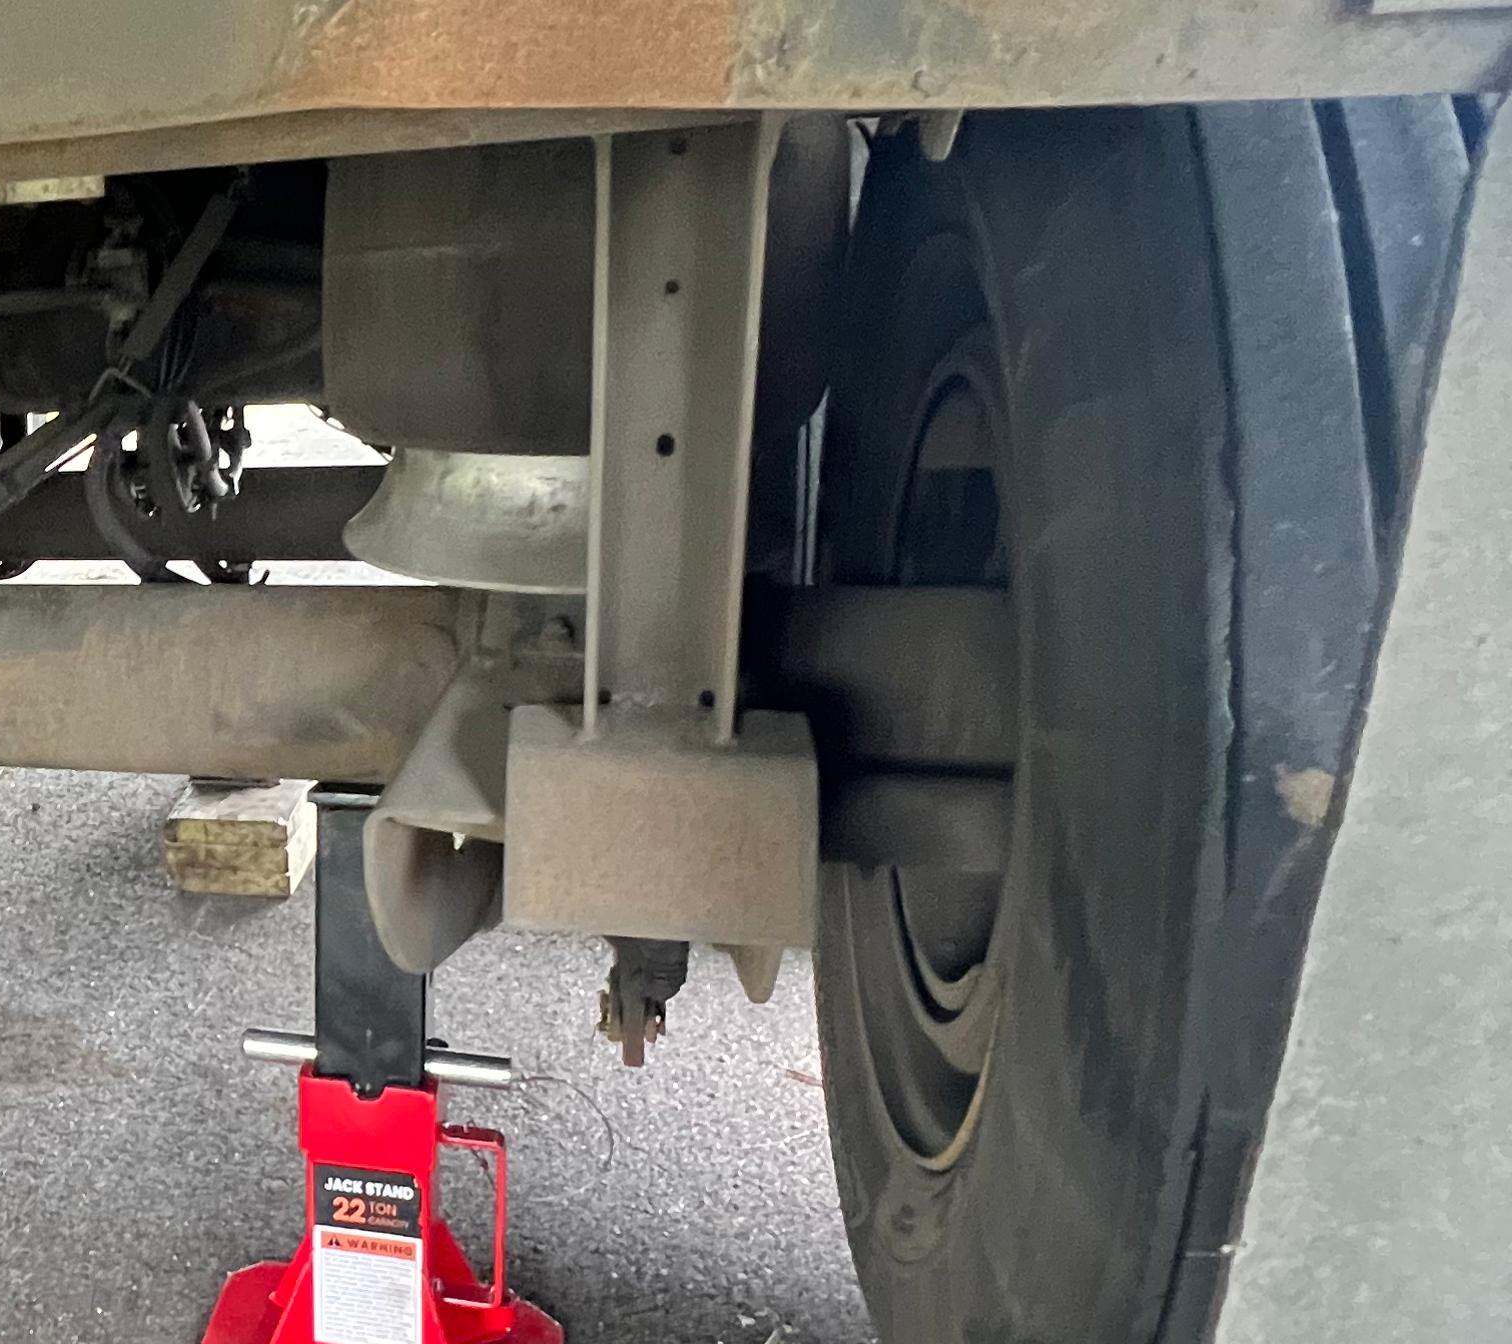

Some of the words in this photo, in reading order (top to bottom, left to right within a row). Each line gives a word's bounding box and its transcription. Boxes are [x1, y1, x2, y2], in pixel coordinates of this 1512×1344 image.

[323, 1177, 363, 1194] JACK
[365, 1182, 414, 1201] STAND
[332, 1196, 366, 1224] 22
[368, 1200, 397, 1217] TON
[347, 1239, 413, 1256] WARNING
